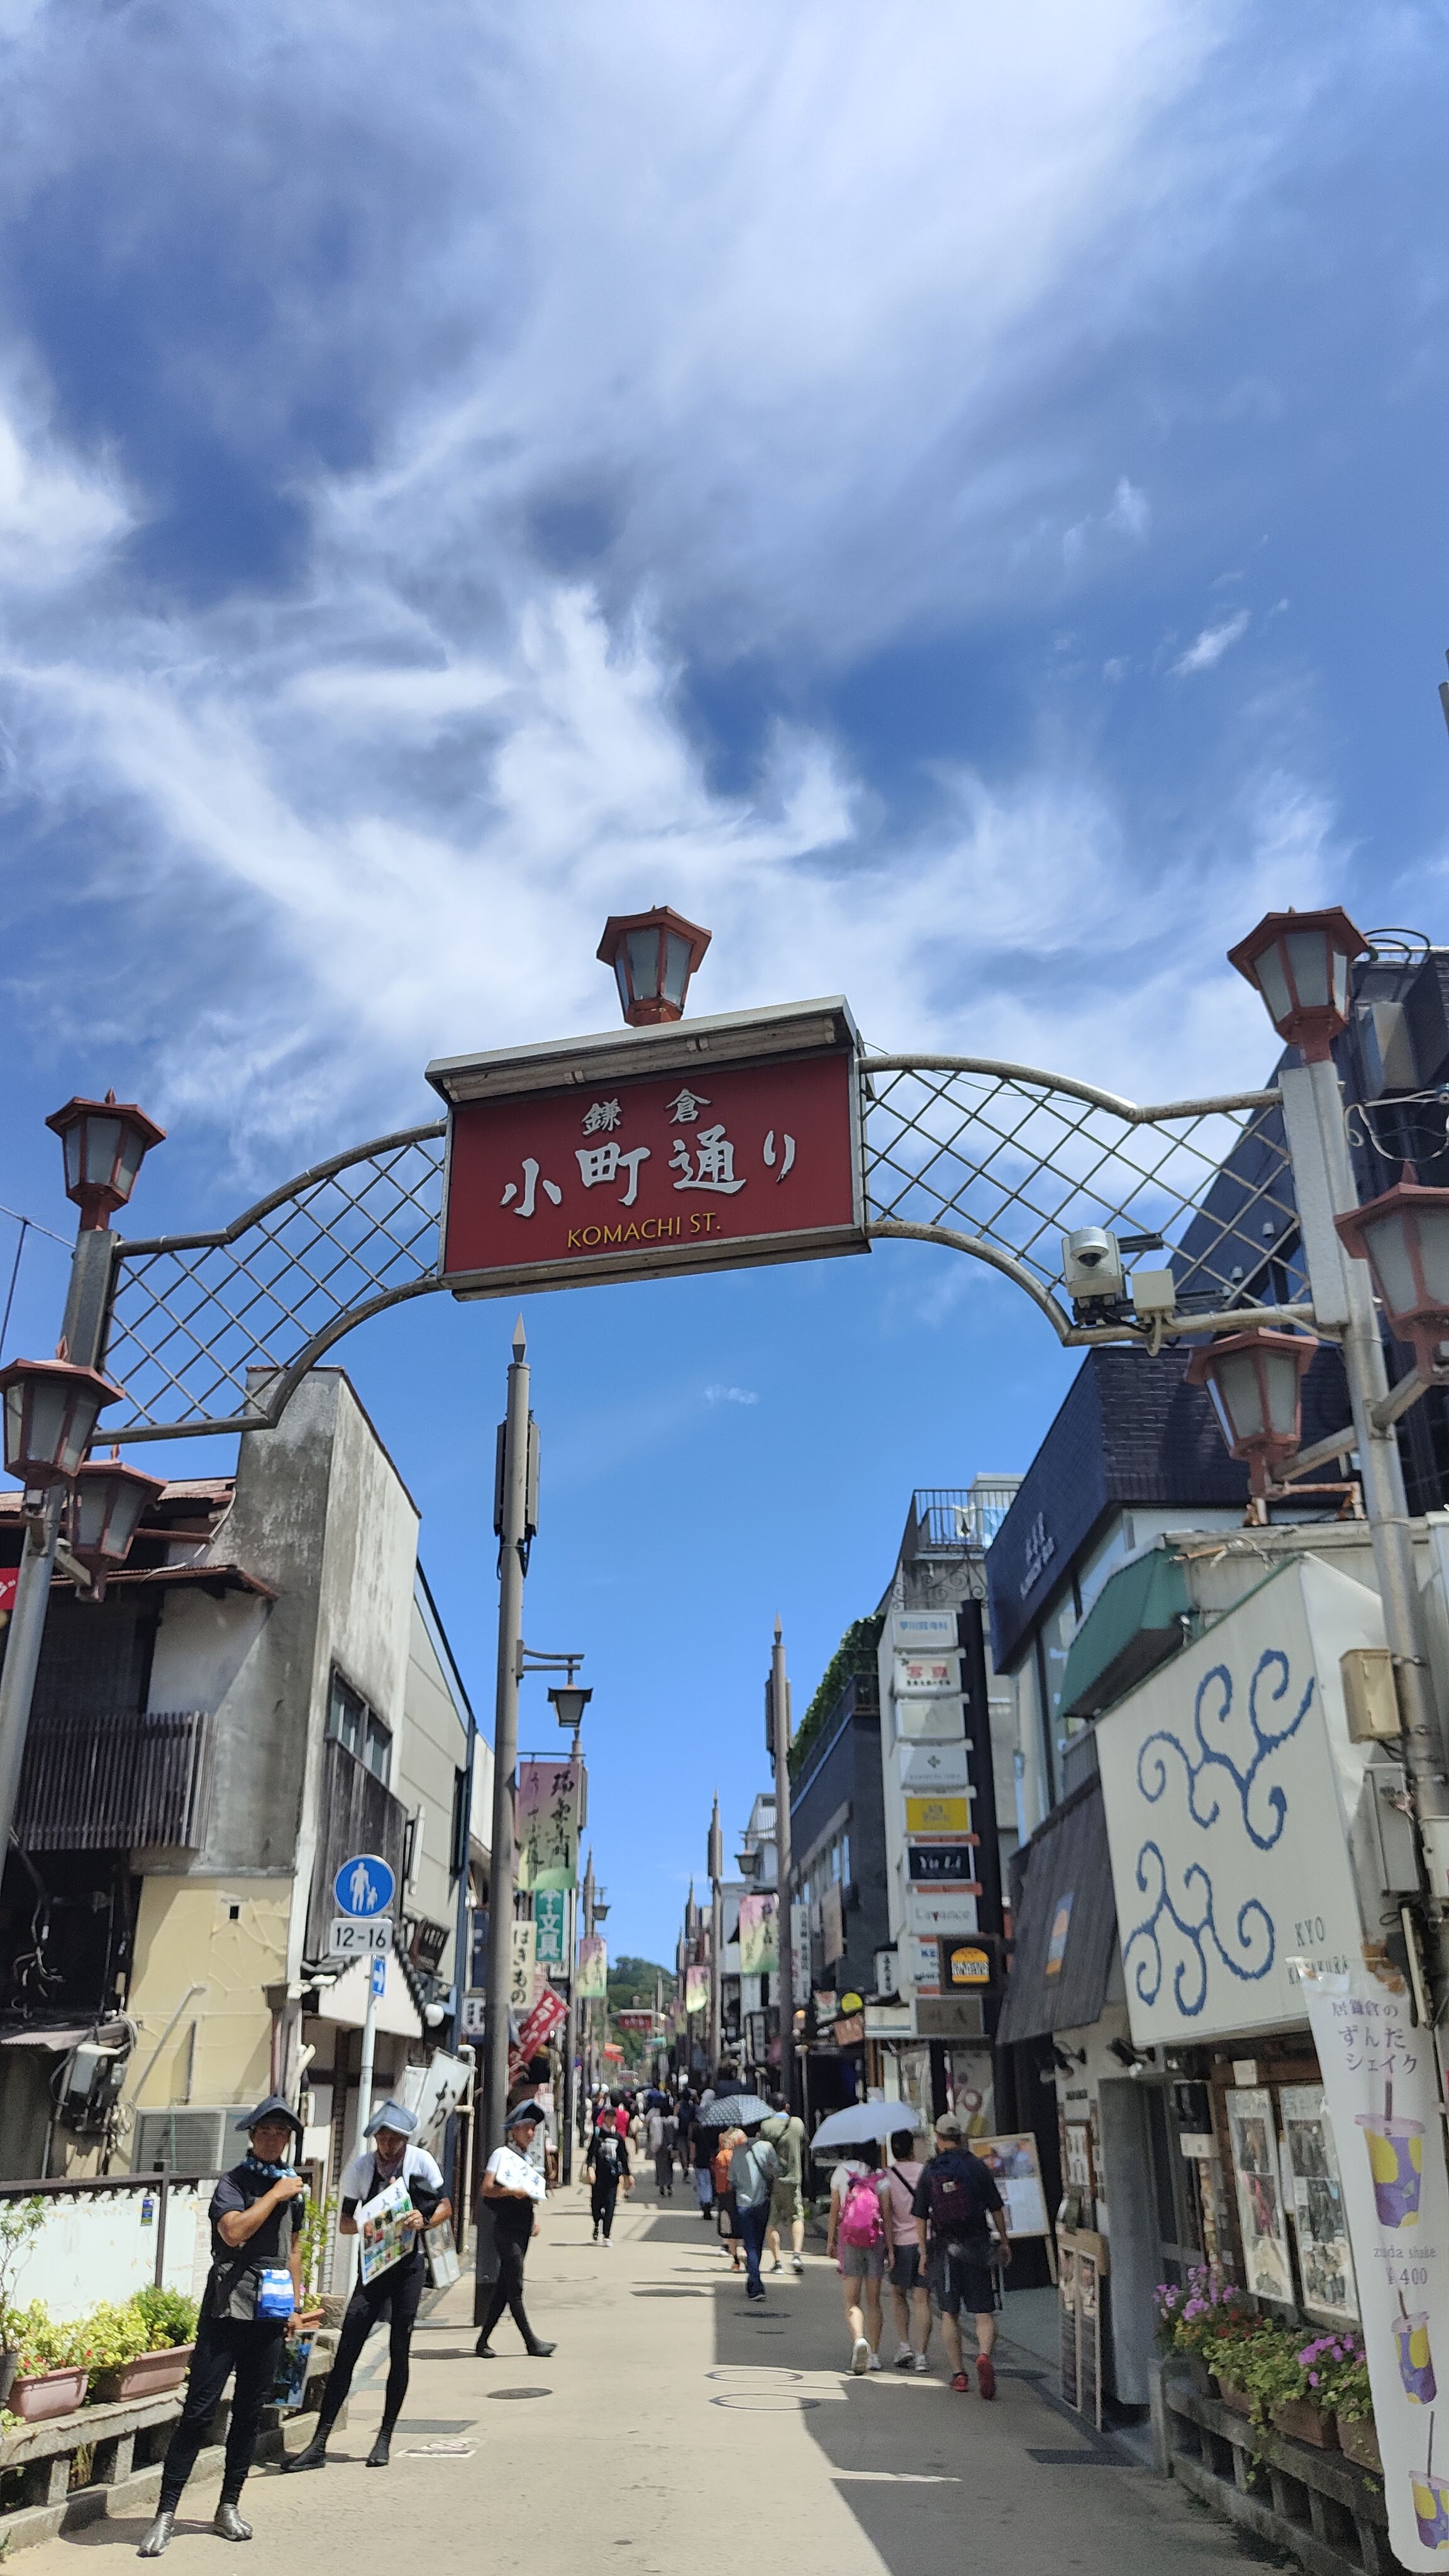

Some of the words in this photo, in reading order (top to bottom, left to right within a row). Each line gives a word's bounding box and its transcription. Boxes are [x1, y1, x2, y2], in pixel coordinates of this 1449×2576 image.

[581, 1088, 712, 1136] 鎌倉
[499, 1123, 796, 1218] 小町通り
[567, 1216, 681, 1248] KOMACHI
[689, 1212, 722, 1233] ST.
[336, 1926, 386, 1948] 12-16
[1294, 1916, 1324, 1947] KYO
[511, 1928, 529, 2004] はきもの
[1338, 2024, 1406, 2049] ずんだ
[1346, 2052, 1418, 2075] シェイク
